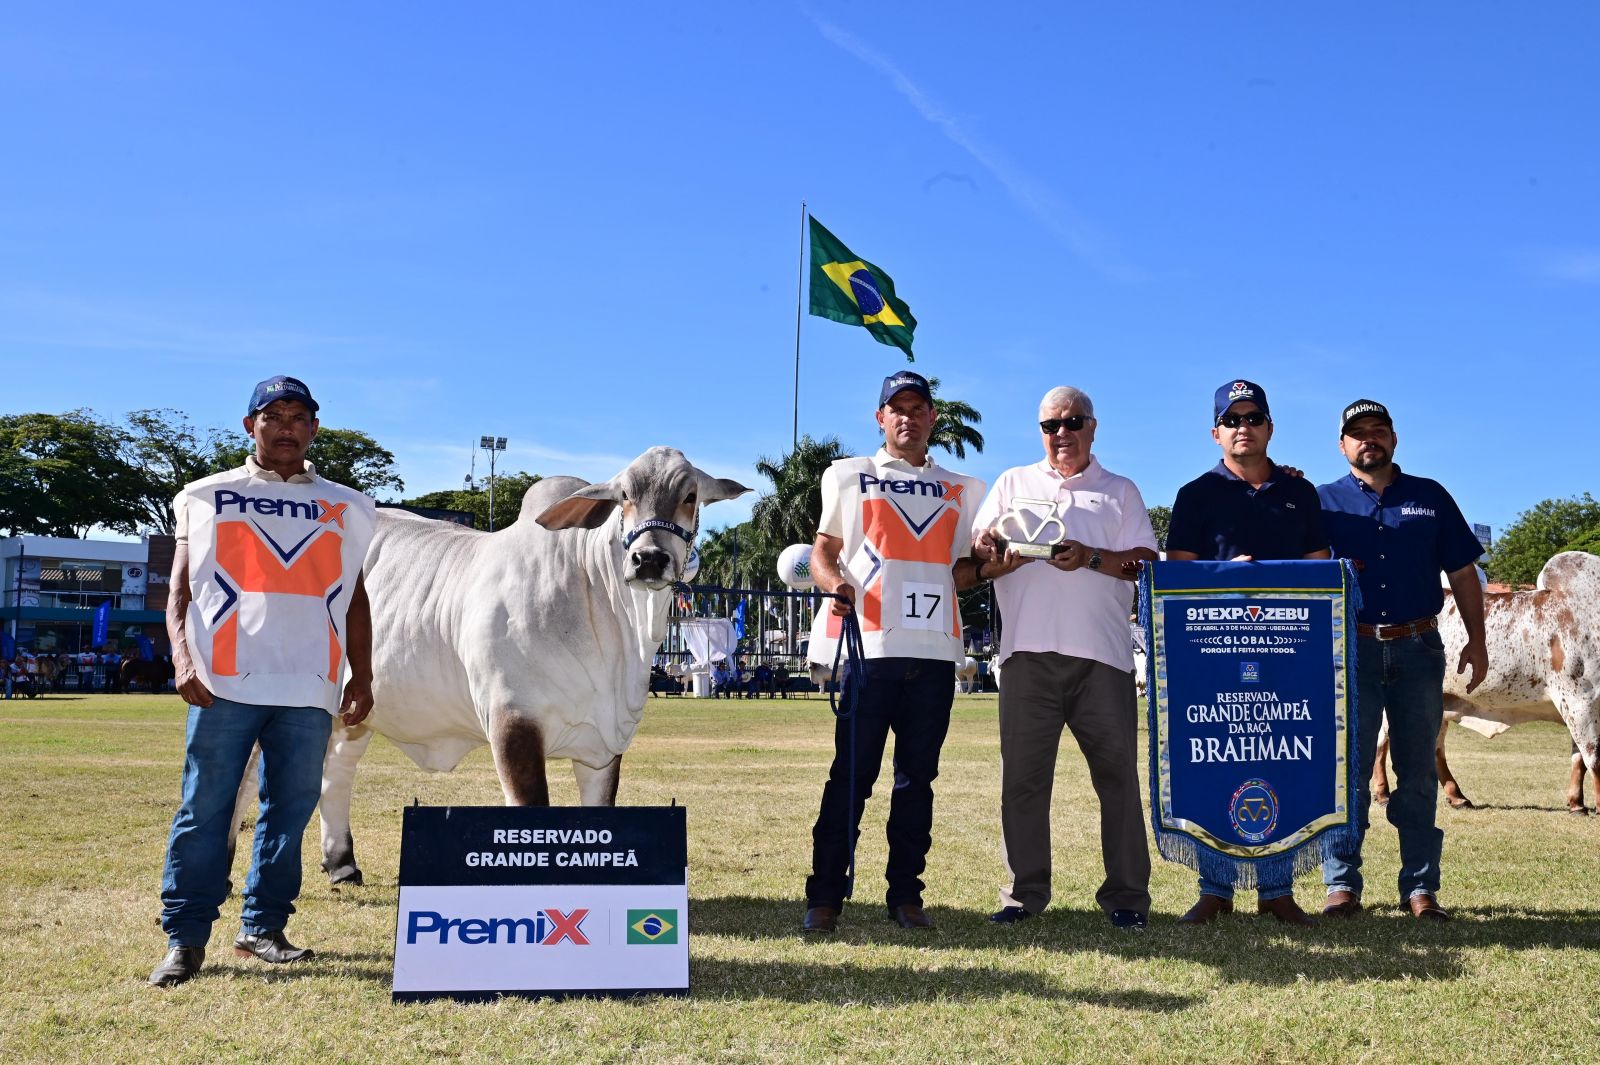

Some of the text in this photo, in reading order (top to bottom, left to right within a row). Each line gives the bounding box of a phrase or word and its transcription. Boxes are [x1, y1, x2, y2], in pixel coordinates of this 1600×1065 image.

[1228, 389, 1254, 399] ABCZ
[1401, 507, 1436, 517] BRAHMAN
[906, 592, 941, 619] 17
[1223, 636, 1273, 645] GLOBAL
[1216, 691, 1279, 703] RESERVADA
[1186, 699, 1312, 723] GRANDE CAMPEÃ
[1228, 722, 1272, 735] DA RAÇA
[1189, 735, 1314, 763] BRAHMAN
[493, 829, 613, 844] RESERVADO
[465, 849, 639, 867] GRANDE CAMPEÃ
